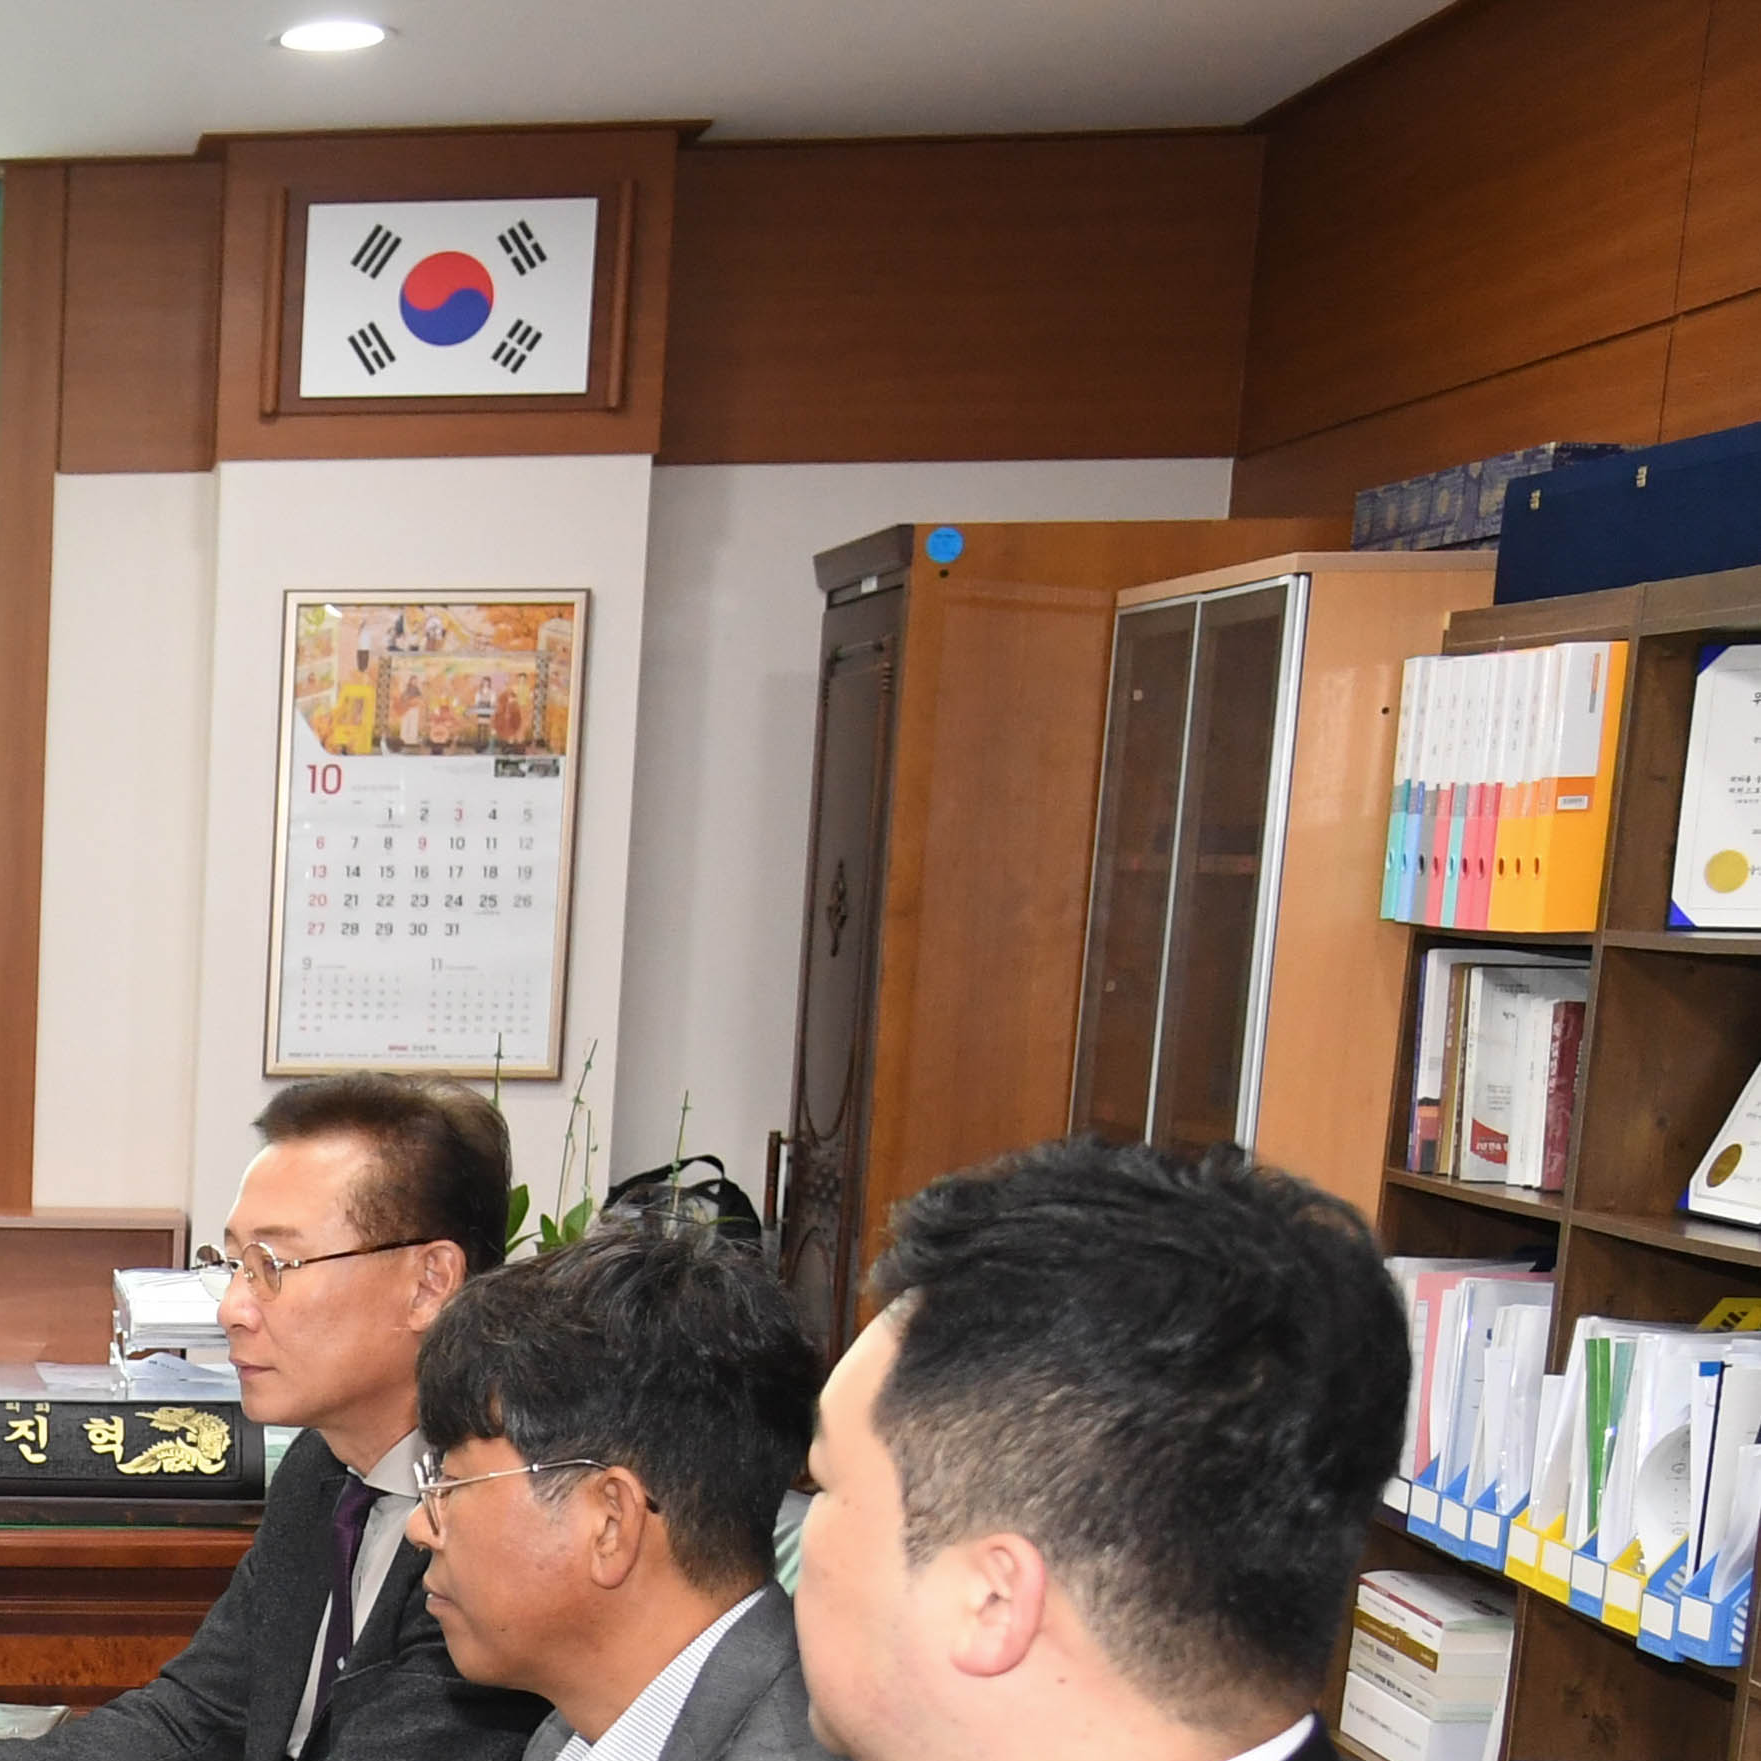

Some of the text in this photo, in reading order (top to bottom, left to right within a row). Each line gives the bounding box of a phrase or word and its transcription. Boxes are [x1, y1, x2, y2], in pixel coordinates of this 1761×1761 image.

[306, 763, 342, 795] 10
[419, 807, 429, 821] 2
[453, 807, 464, 821] 3
[488, 807, 498, 821] 4
[522, 807, 533, 821] 5
[315, 836, 534, 850] 6 7 8 9 10 11 12
[311, 865, 532, 879] 13 14 15 16 17 18 19
[308, 894, 533, 908] 20 21 22 23 24 25 26
[307, 922, 460, 936] 27 28 29 30 31
[301, 957, 312, 970] 9
[430, 958, 443, 971] 11
